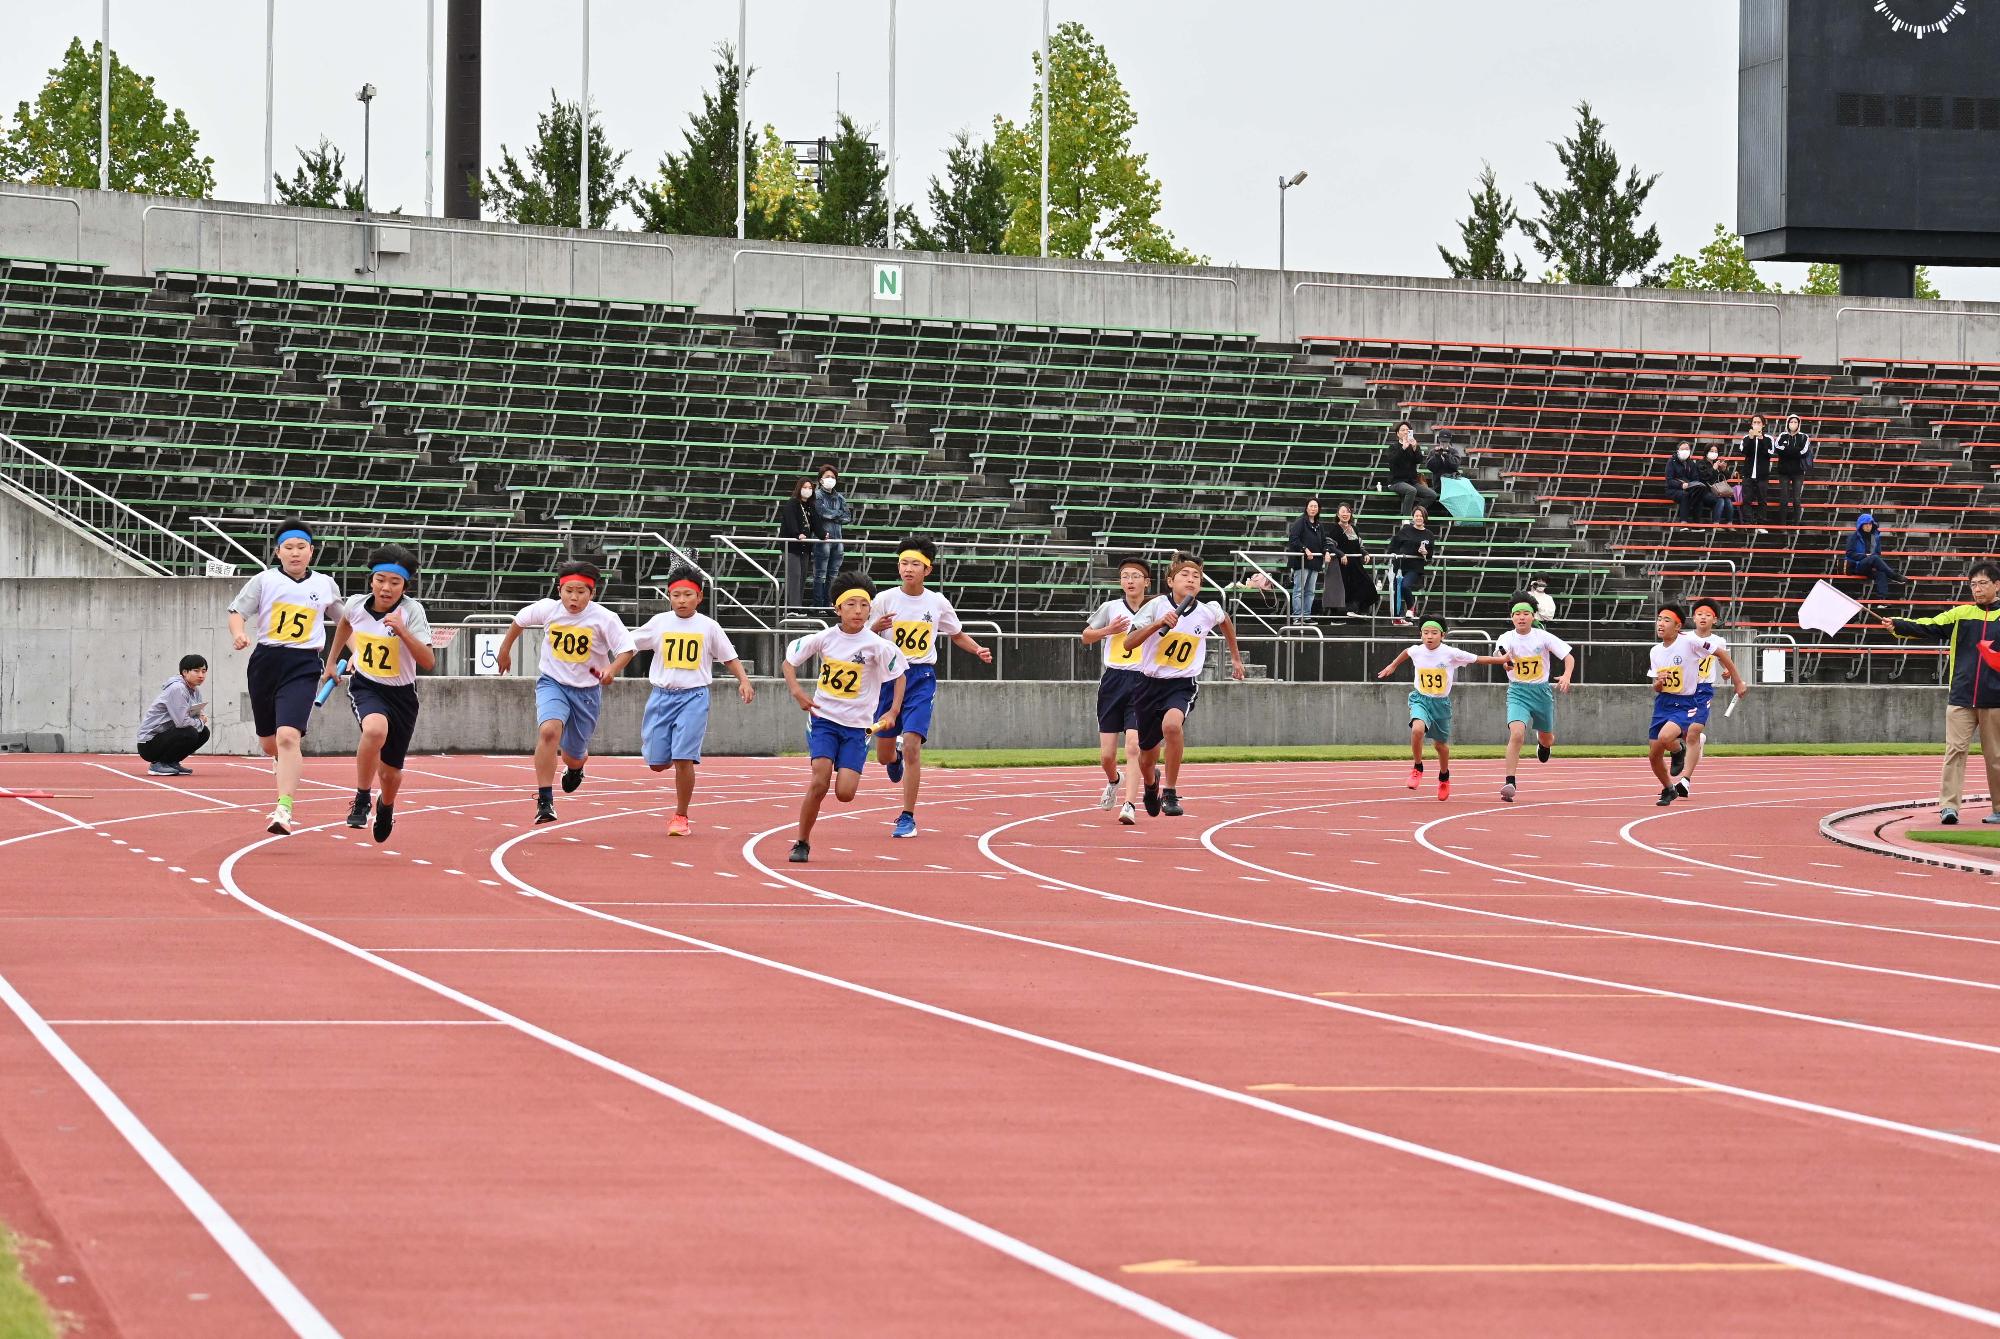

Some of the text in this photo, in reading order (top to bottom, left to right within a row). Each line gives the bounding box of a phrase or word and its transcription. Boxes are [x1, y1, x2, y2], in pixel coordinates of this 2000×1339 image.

[879, 270, 897, 295] N
[277, 610, 308, 638] 15
[551, 630, 589, 656] 708
[665, 638, 699, 662] 710
[895, 627, 930, 651] 866
[362, 642, 392, 670] 42
[1164, 640, 1192, 663] 40
[1516, 661, 1539, 675] 157
[1420, 674, 1443, 688] 139
